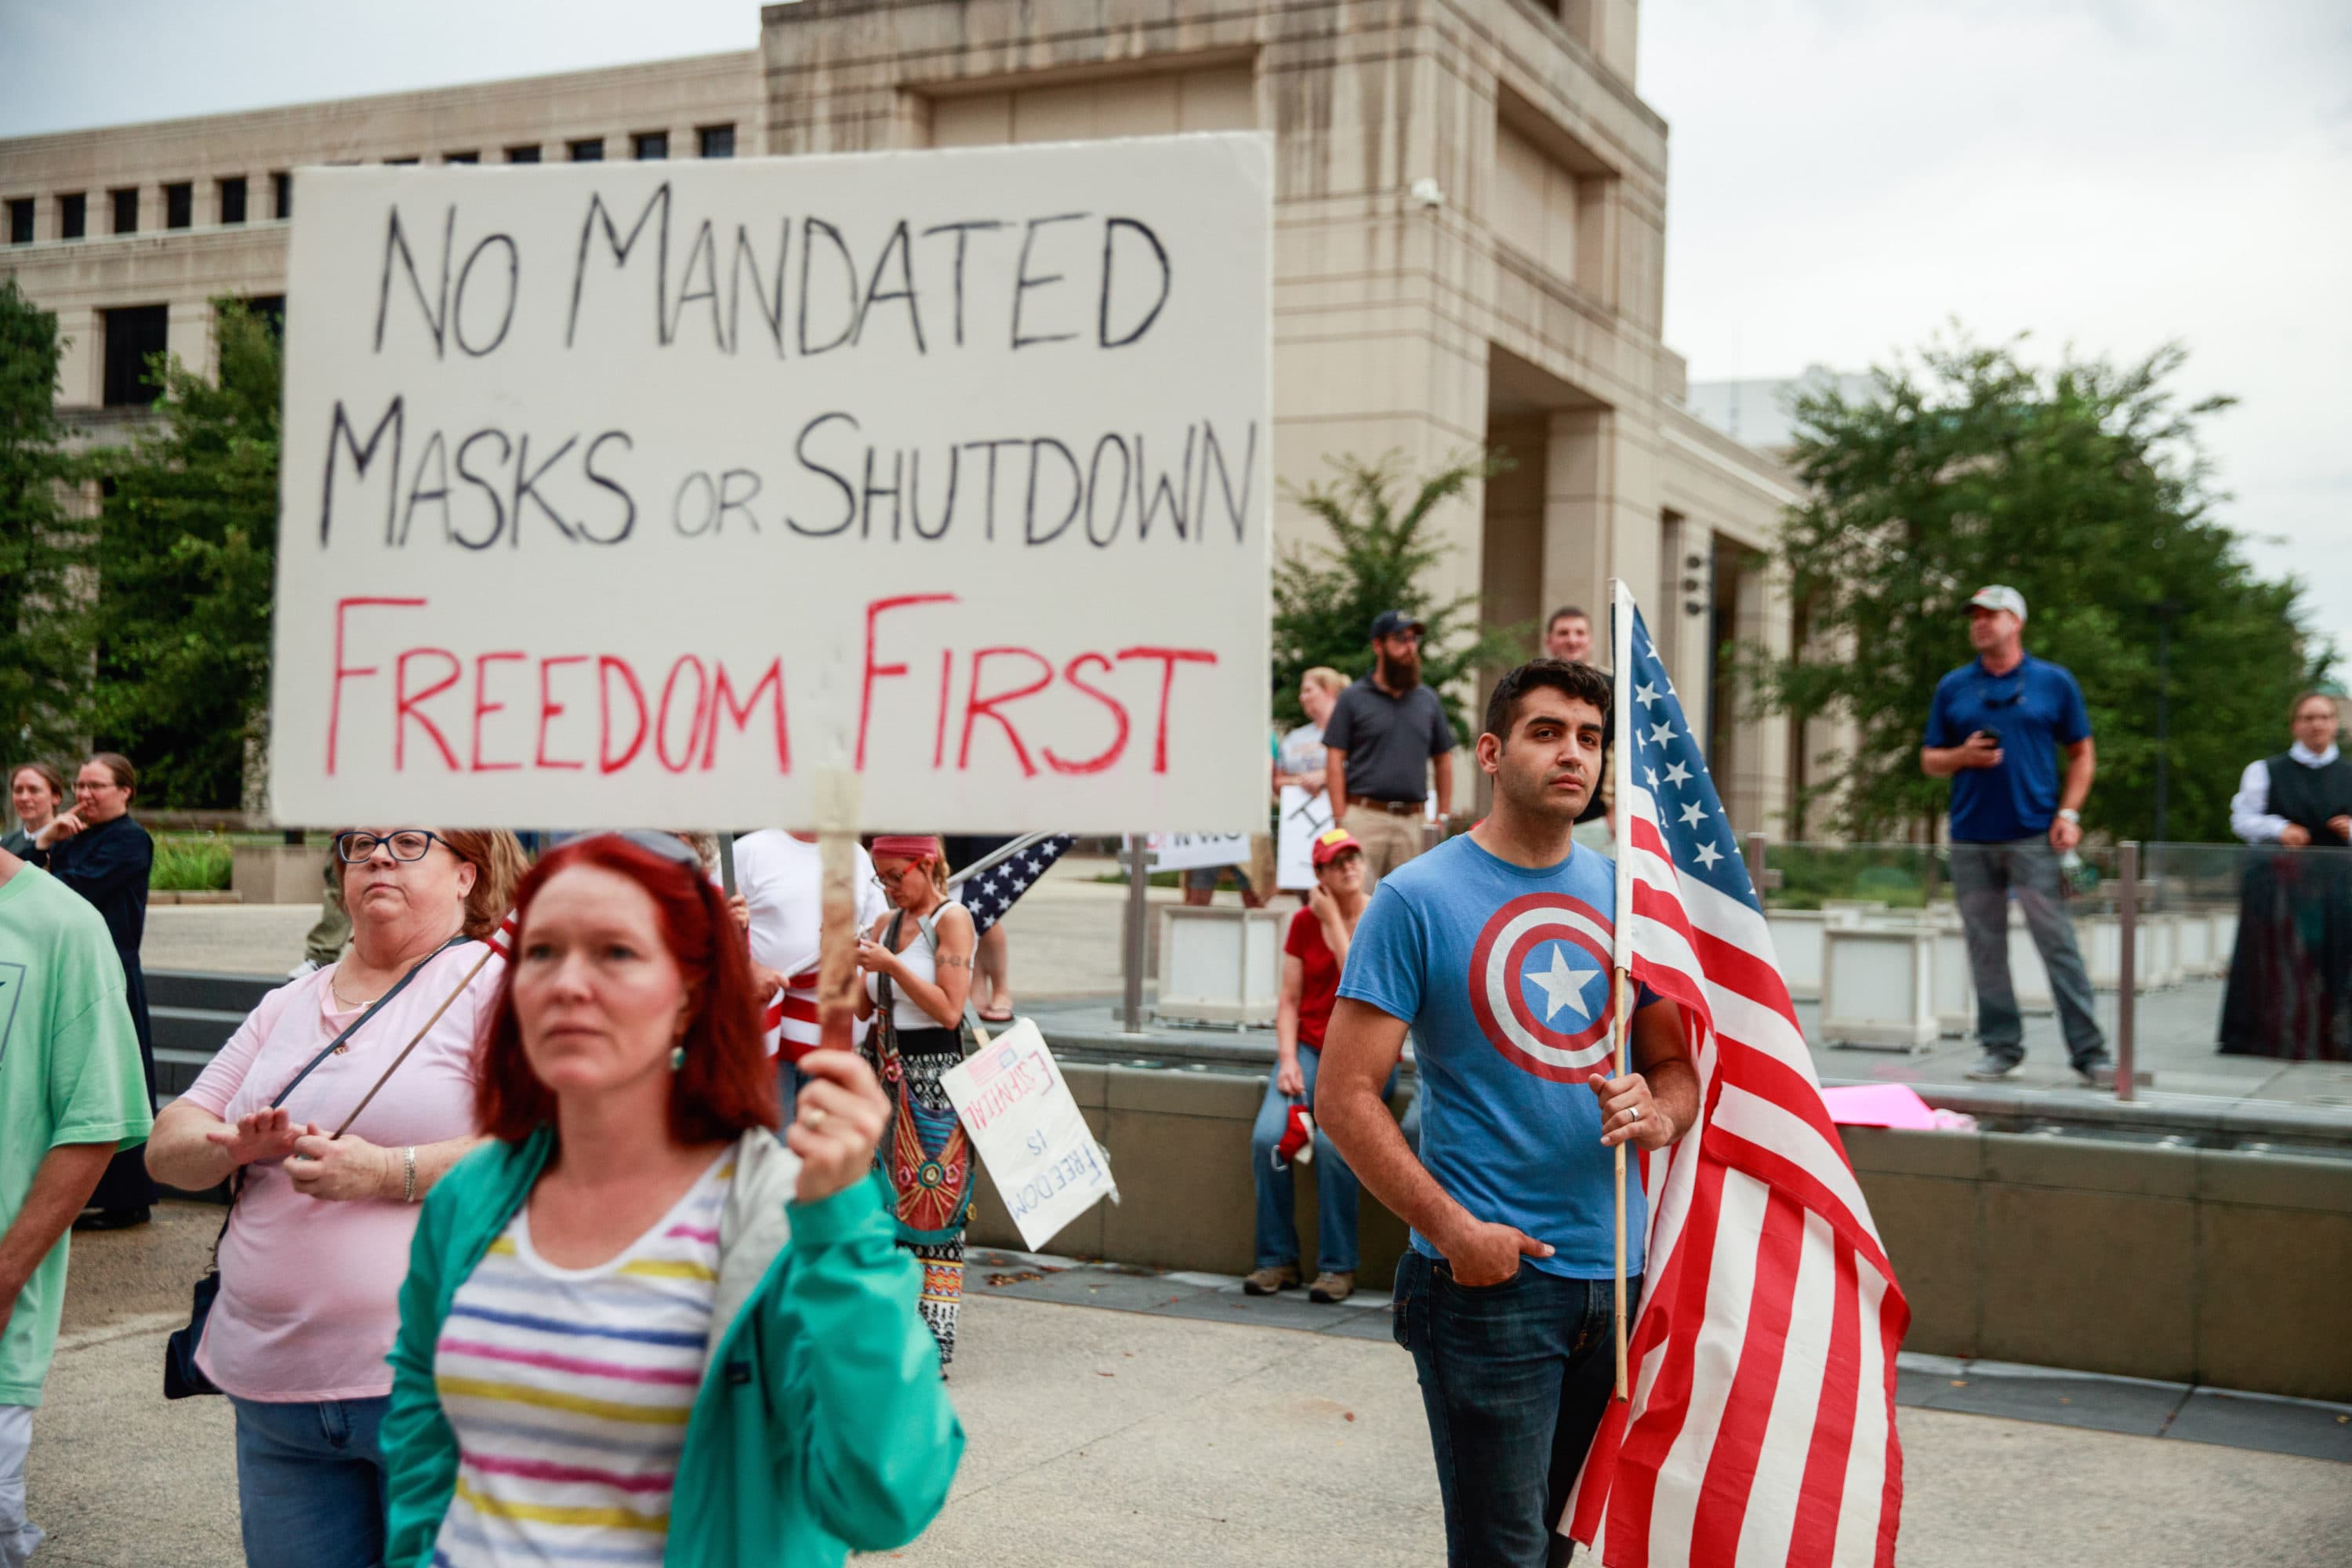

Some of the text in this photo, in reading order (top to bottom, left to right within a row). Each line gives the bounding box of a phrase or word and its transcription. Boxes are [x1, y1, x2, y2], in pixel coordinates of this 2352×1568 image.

[375, 180, 1171, 359] NO MANDATED
[319, 394, 1258, 550] MASKS OR SHUTDOWN
[326, 591, 1218, 779] FREEDOM FIRST
[1007, 1143, 1104, 1220] FREEDOM
[1027, 1128, 1047, 1157] IS
